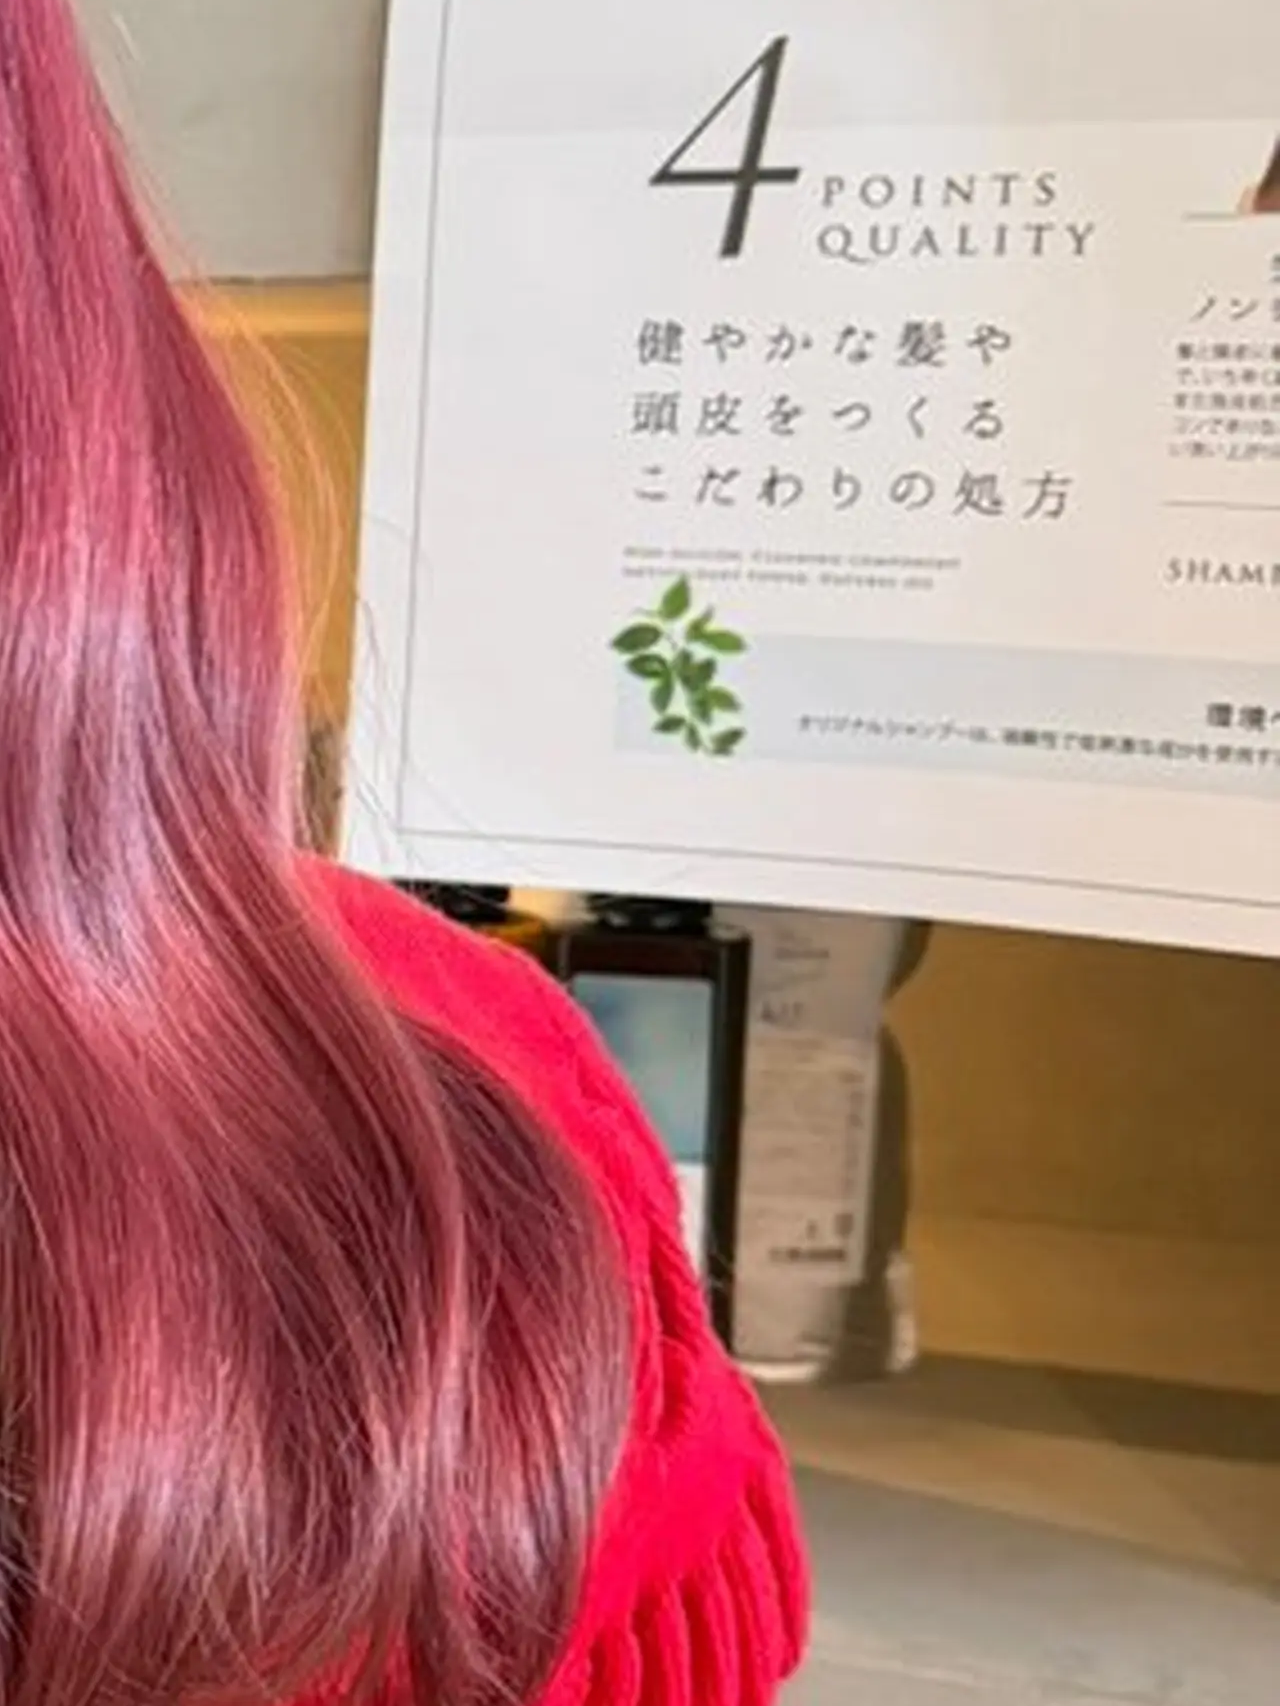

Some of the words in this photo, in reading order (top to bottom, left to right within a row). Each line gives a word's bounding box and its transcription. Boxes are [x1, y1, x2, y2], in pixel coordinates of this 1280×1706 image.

[648, 33, 803, 260] 4
[819, 172, 1060, 208] POINTS
[814, 221, 1097, 264] QUALITY
[636, 318, 1013, 368] 健やかな髪や
[630, 390, 1005, 440] 頭皮をつくる
[634, 464, 1074, 520] こだわりの処方
